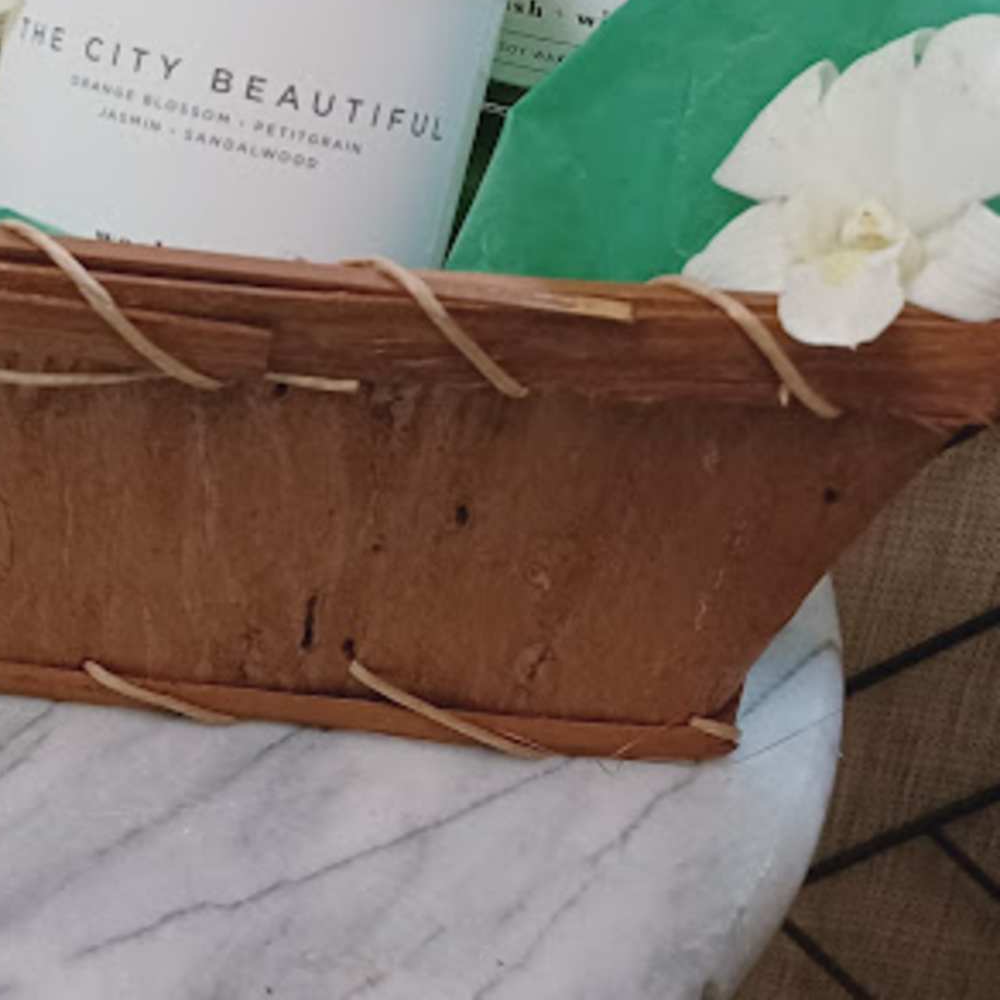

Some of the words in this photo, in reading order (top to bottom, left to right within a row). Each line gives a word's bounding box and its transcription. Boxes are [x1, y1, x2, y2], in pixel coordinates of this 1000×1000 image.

[19, 15, 67, 52] THE
[83, 35, 184, 82] CITY
[209, 65, 447, 143] BEAUTIFUL
[97, 106, 162, 132] JASMIN
[183, 127, 319, 169] SANDALWOOD
[142, 93, 231, 124] BLOSSOM
[252, 119, 364, 155] PETITGRAIN
